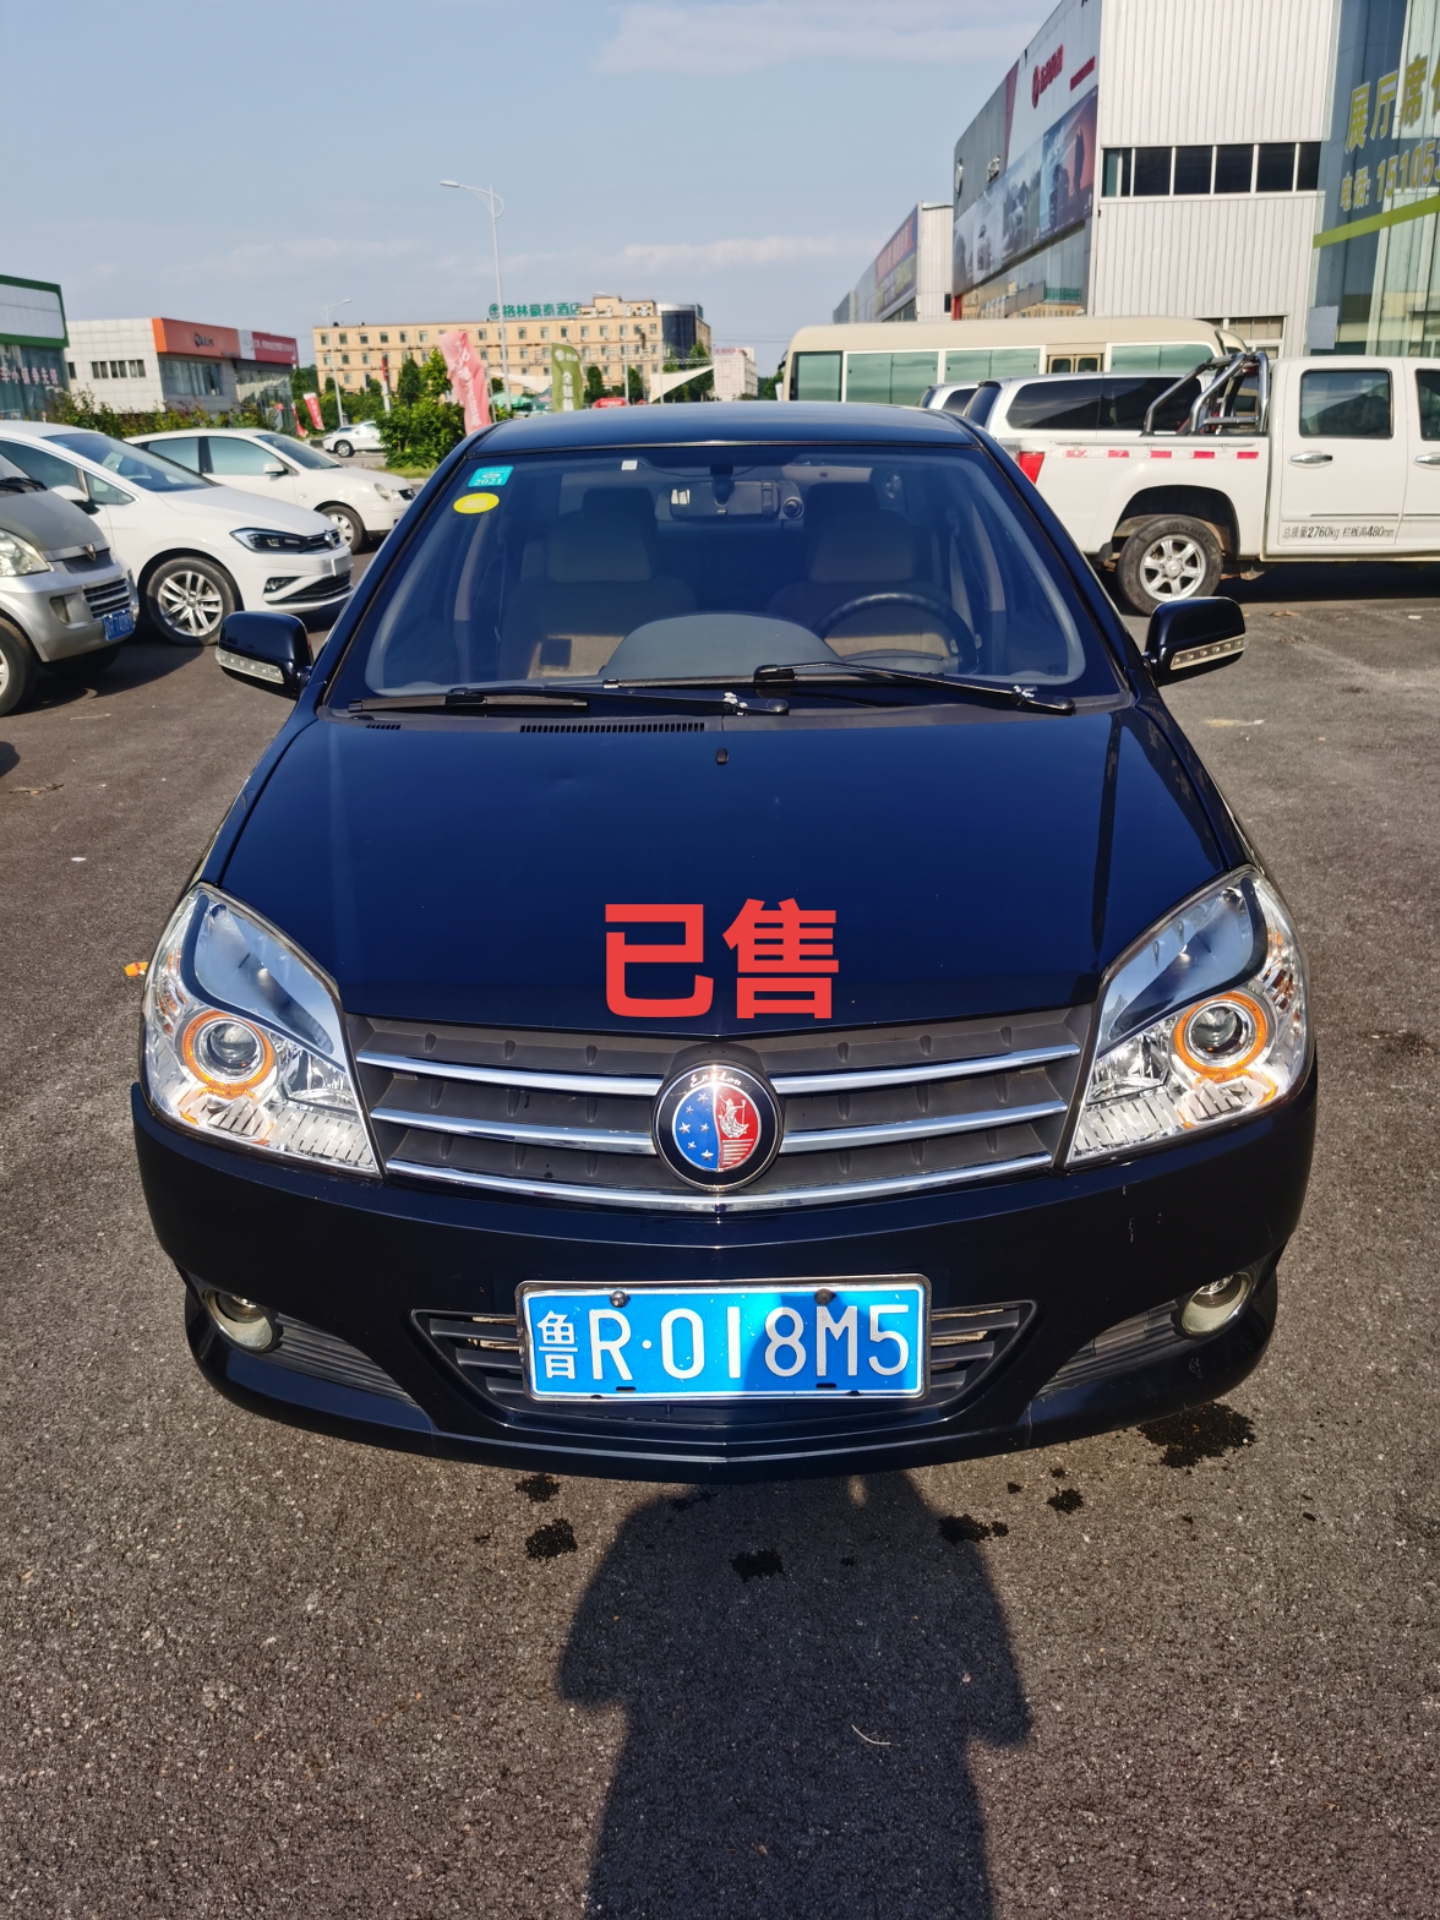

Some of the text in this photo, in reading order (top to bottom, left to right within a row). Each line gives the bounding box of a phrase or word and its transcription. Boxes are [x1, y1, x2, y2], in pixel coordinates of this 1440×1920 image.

[502, 302, 582, 318] 格林豪泰酒店
[690, 1071, 741, 1088] Englon
[536, 1304, 910, 1381] 鲁R·018M5
